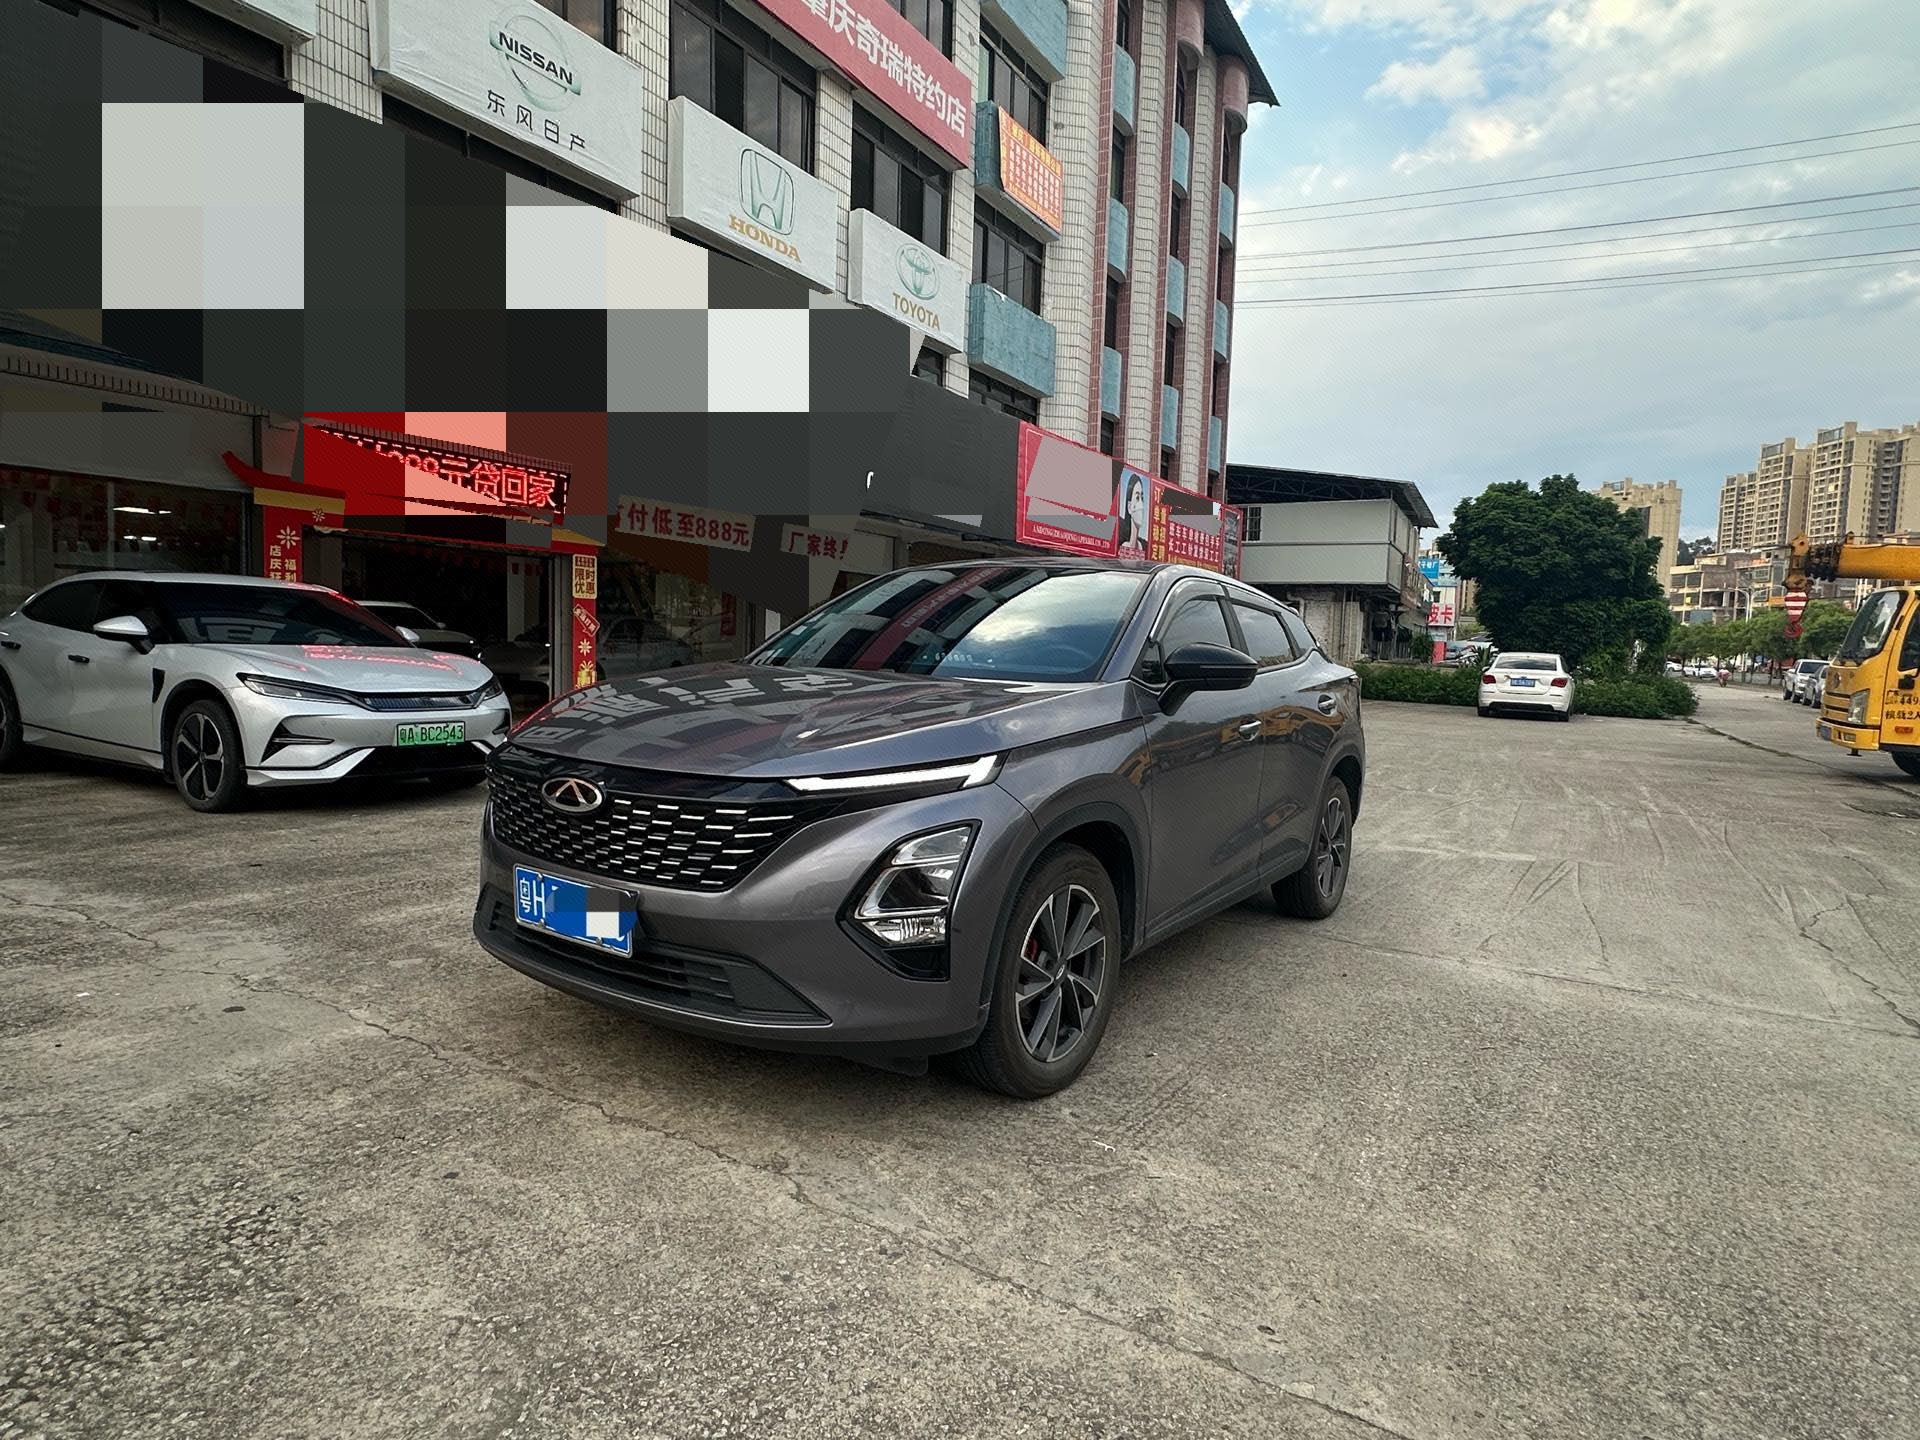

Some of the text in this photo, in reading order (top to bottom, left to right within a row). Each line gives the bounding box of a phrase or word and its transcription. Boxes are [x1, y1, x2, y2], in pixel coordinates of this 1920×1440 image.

[499, 31, 573, 85] NISSAN
[487, 89, 586, 150] 东风日产
[728, 214, 802, 263] HONDA
[892, 291, 941, 331] TOYOTA
